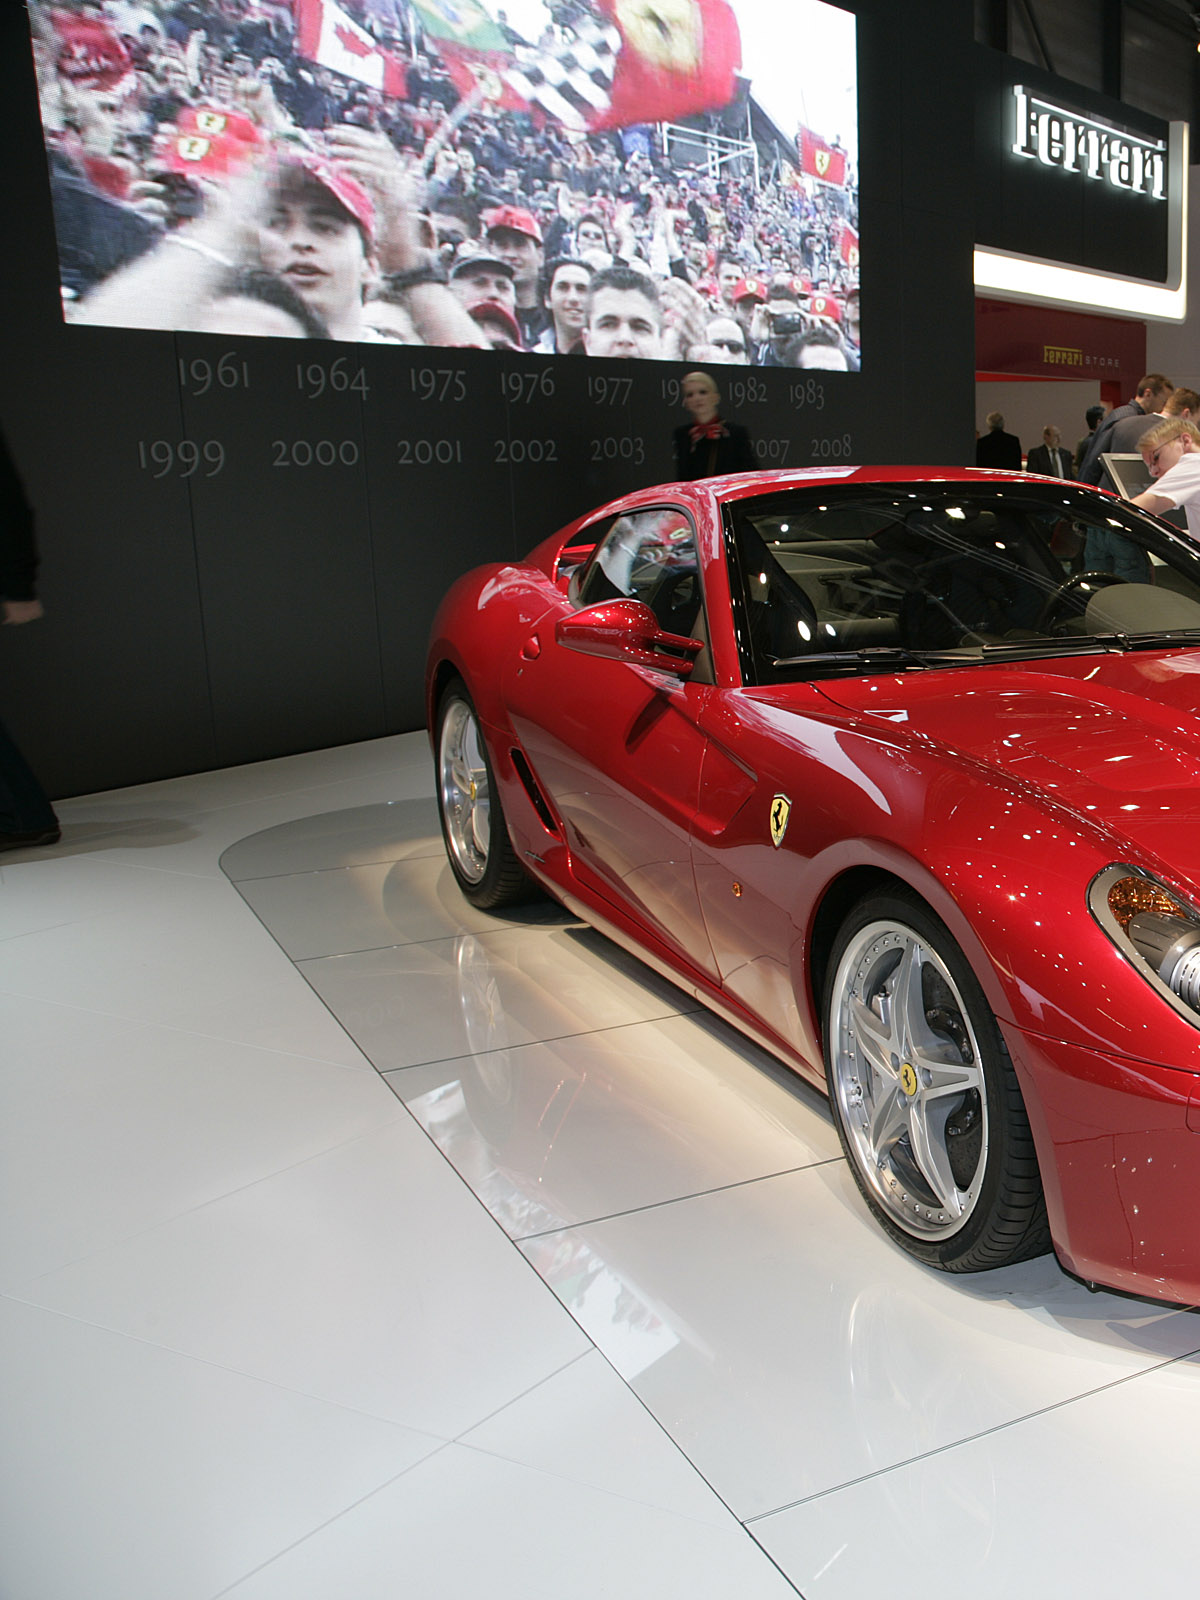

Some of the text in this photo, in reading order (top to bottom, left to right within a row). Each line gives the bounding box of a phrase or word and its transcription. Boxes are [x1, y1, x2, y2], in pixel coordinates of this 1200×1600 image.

[1012, 84, 1168, 200] Ferrari
[178, 351, 250, 396] 1961
[296, 356, 370, 401] 1964
[410, 366, 468, 402] 1975
[499, 366, 556, 404] 1976
[587, 375, 634, 407] 1977
[728, 376, 768, 408] 1982
[789, 378, 826, 410] 1983
[1043, 345, 1083, 366] Ferrari
[137, 439, 226, 479] 1999
[271, 440, 360, 467] 2000
[397, 439, 463, 465] 2001
[494, 439, 559, 463] 2002
[590, 436, 646, 465] 2003
[810, 433, 853, 458] 2008
